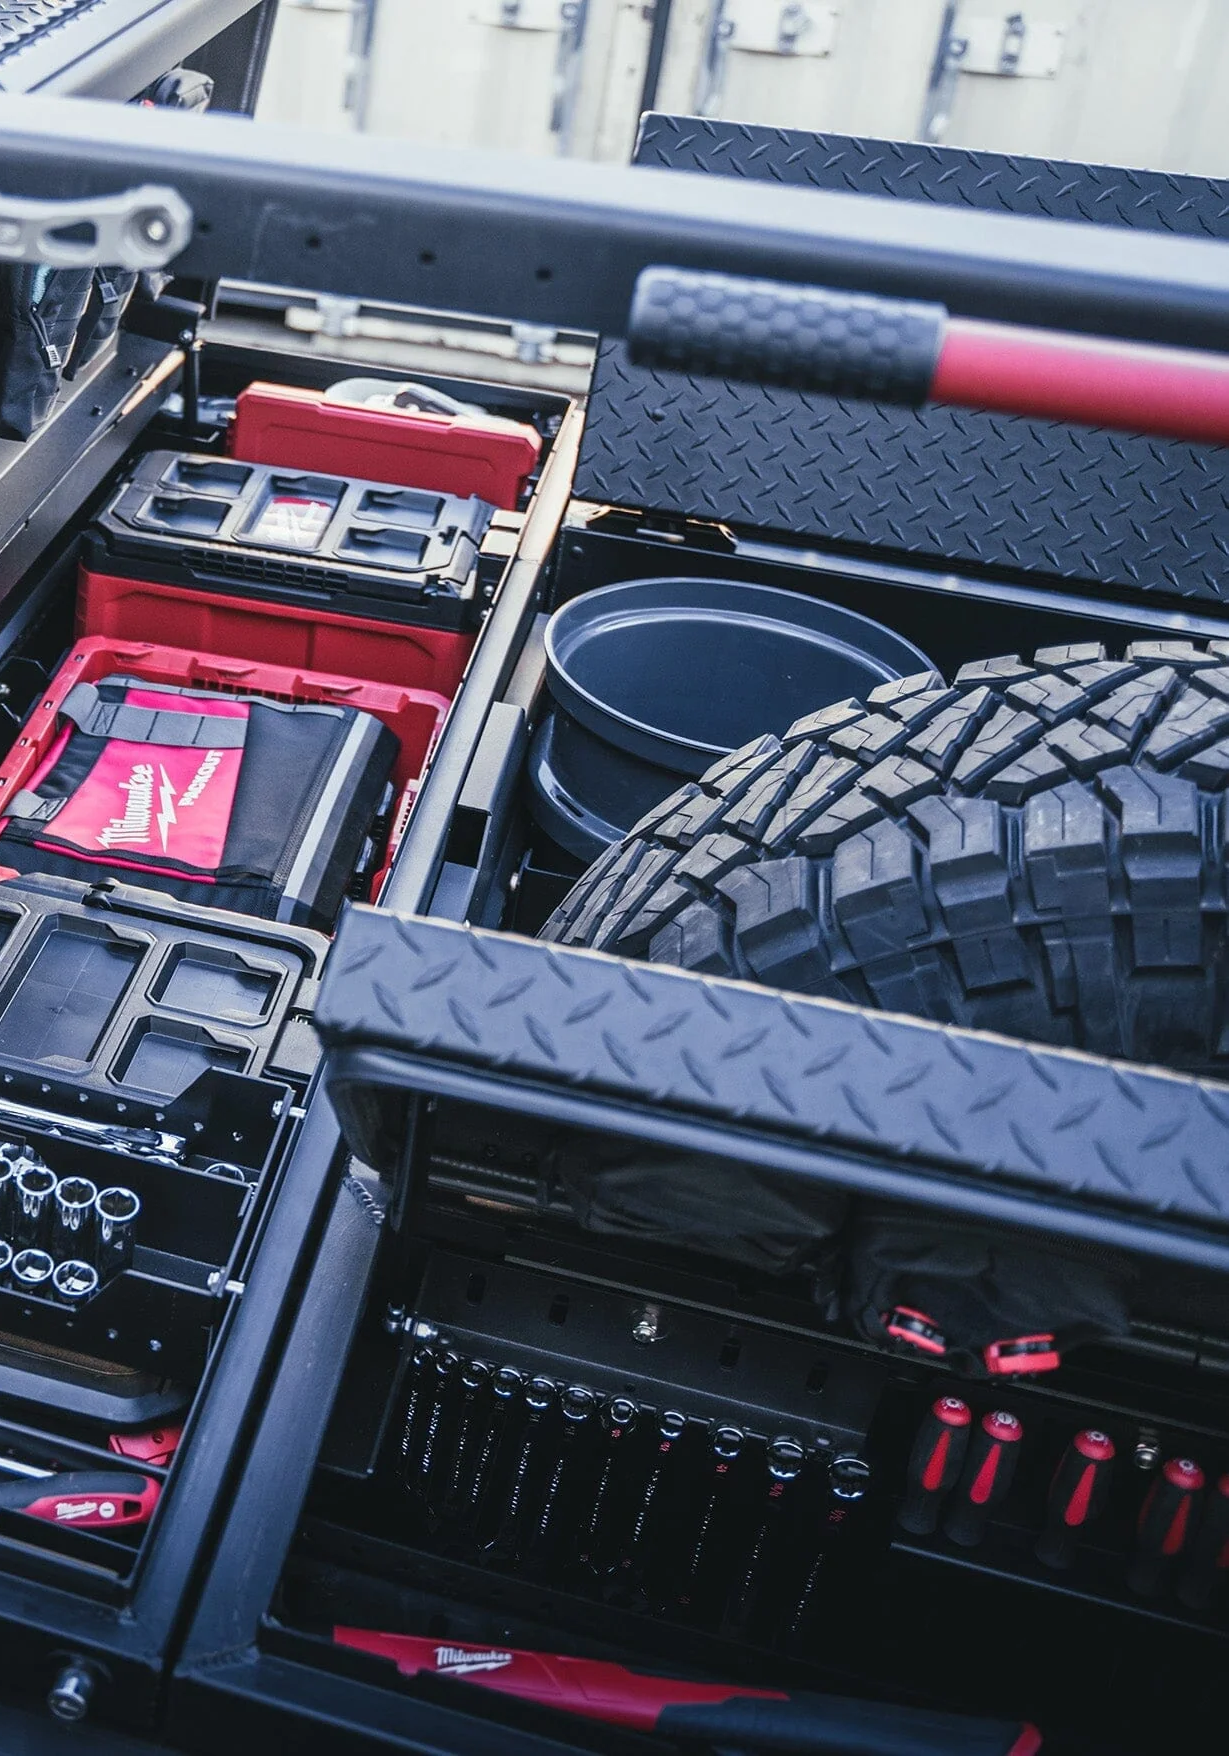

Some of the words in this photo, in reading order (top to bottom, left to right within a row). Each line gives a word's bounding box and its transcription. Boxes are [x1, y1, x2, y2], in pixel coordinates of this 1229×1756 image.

[95, 763, 154, 849] Milwaukee
[177, 750, 224, 806] PACKOUT
[434, 1646, 512, 1666] Milwaukee
